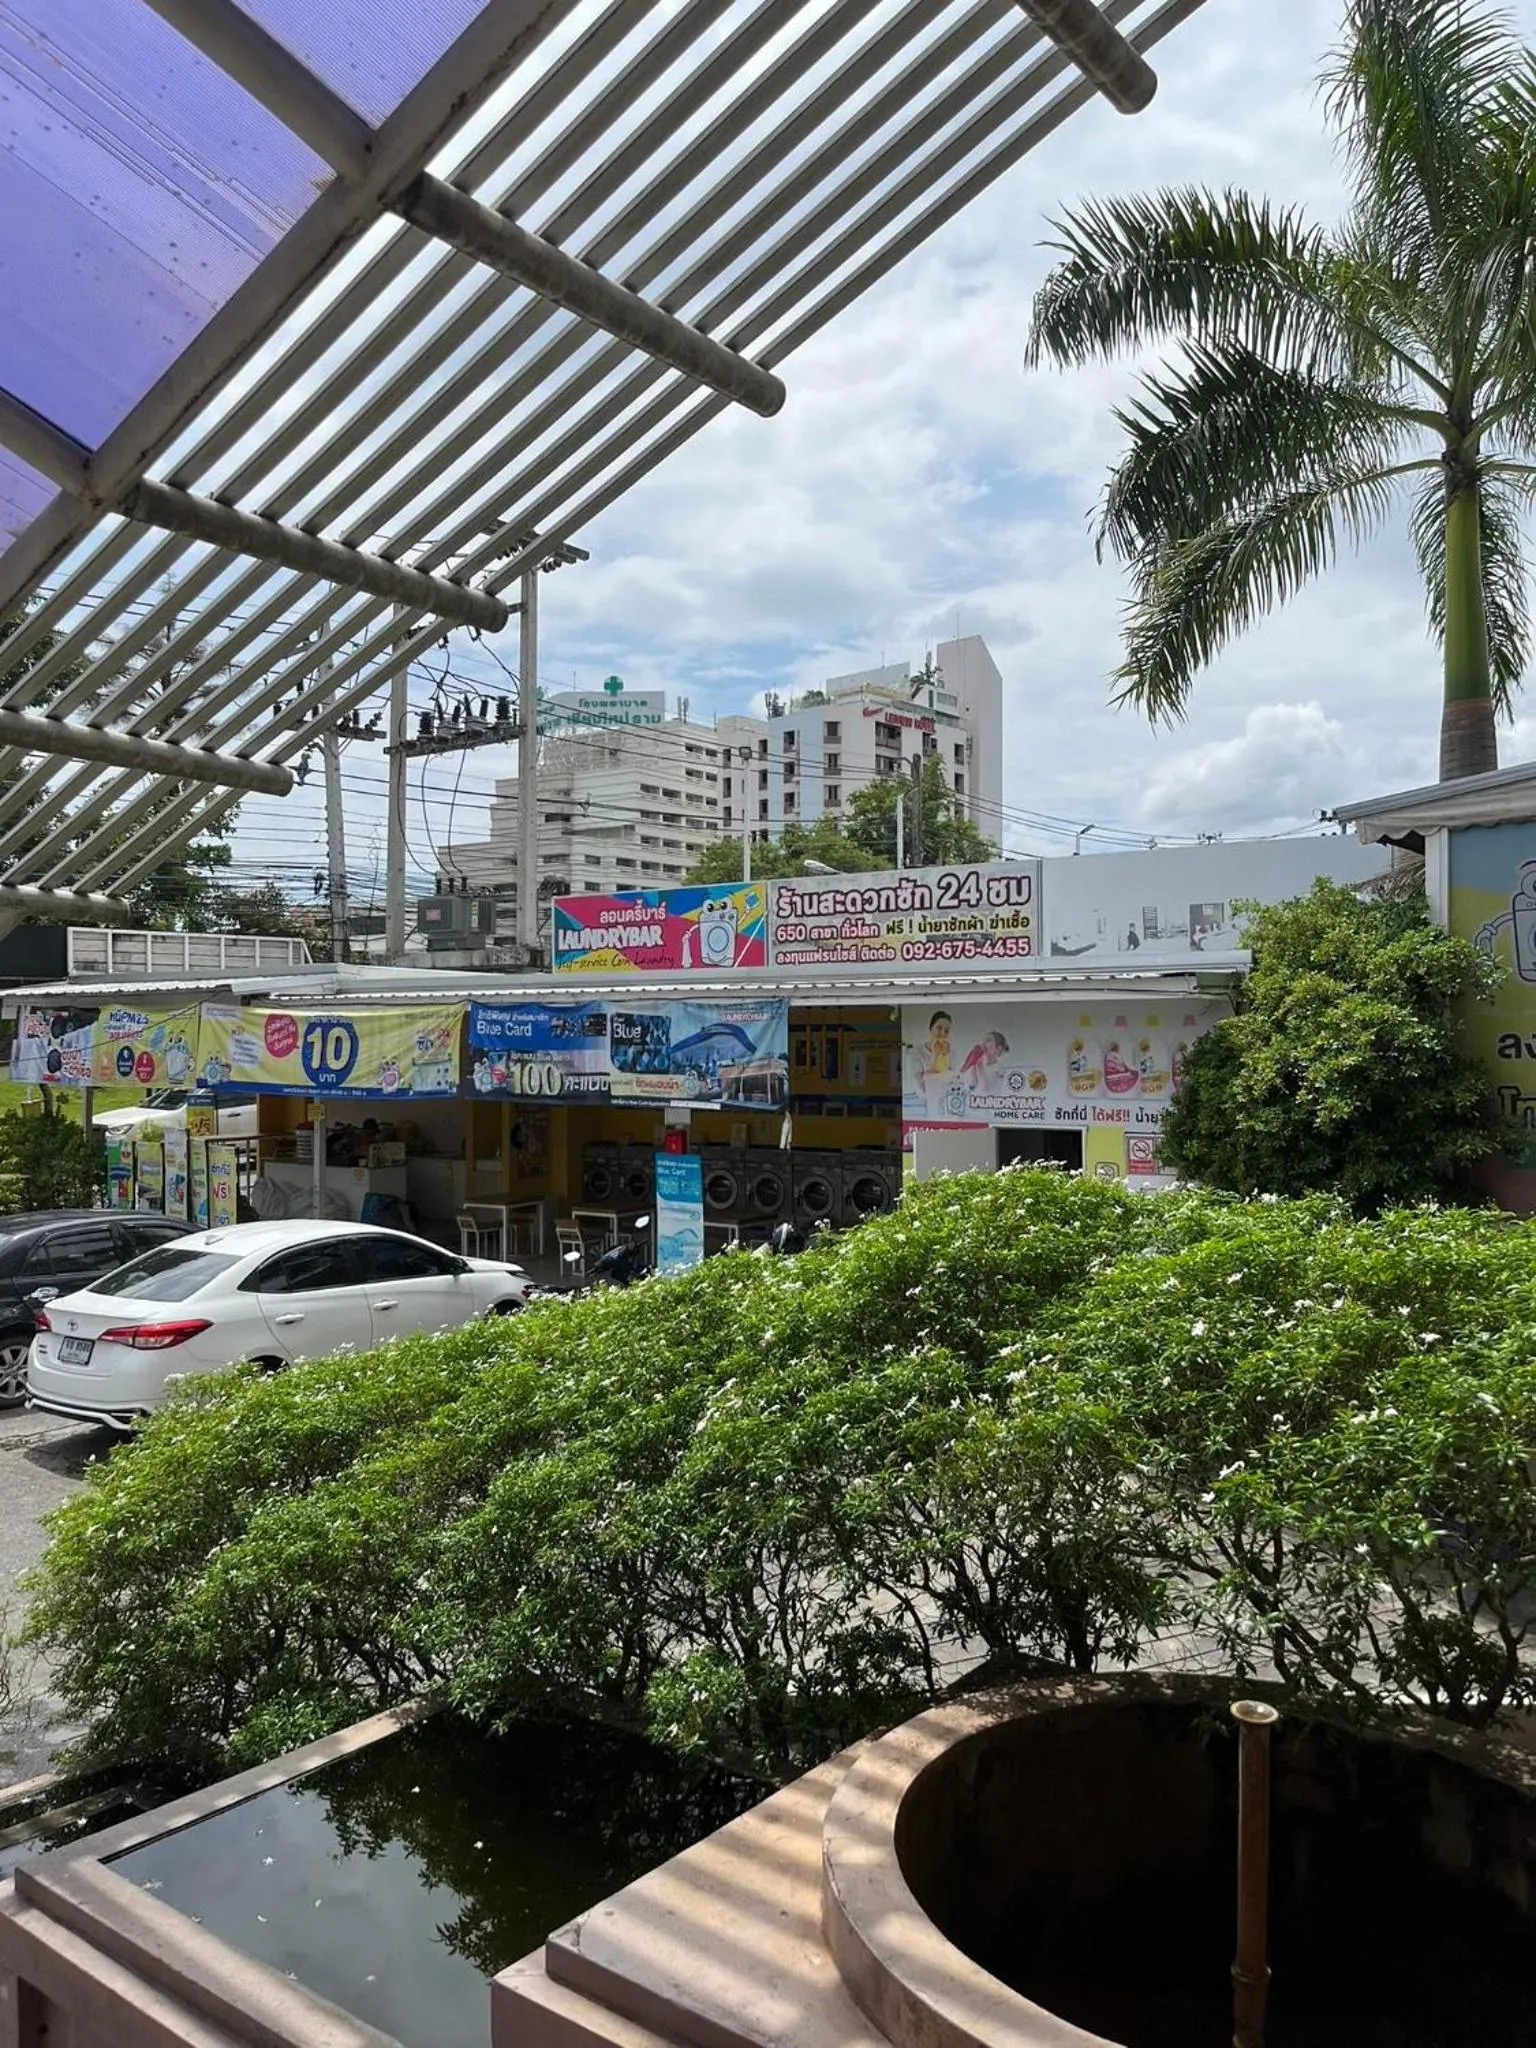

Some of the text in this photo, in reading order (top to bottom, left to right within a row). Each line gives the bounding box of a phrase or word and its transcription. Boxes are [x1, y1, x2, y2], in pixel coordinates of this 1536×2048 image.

[776, 876, 931, 918] ร้านสะดวกซัก
[937, 871, 981, 909] 24
[557, 925, 665, 951] LAUNDRYBAR
[775, 925, 805, 943] 650
[886, 917, 904, 936] ฟรี
[901, 936, 1031, 962] 092-675-4455
[505, 1022, 532, 1037] Card
[613, 1023, 642, 1038] Blue
[306, 1026, 352, 1071] 10
[510, 1063, 562, 1096] 100
[969, 1095, 1045, 1110] LAUNDRYBAR
[994, 1111, 1045, 1120] HOME CARE
